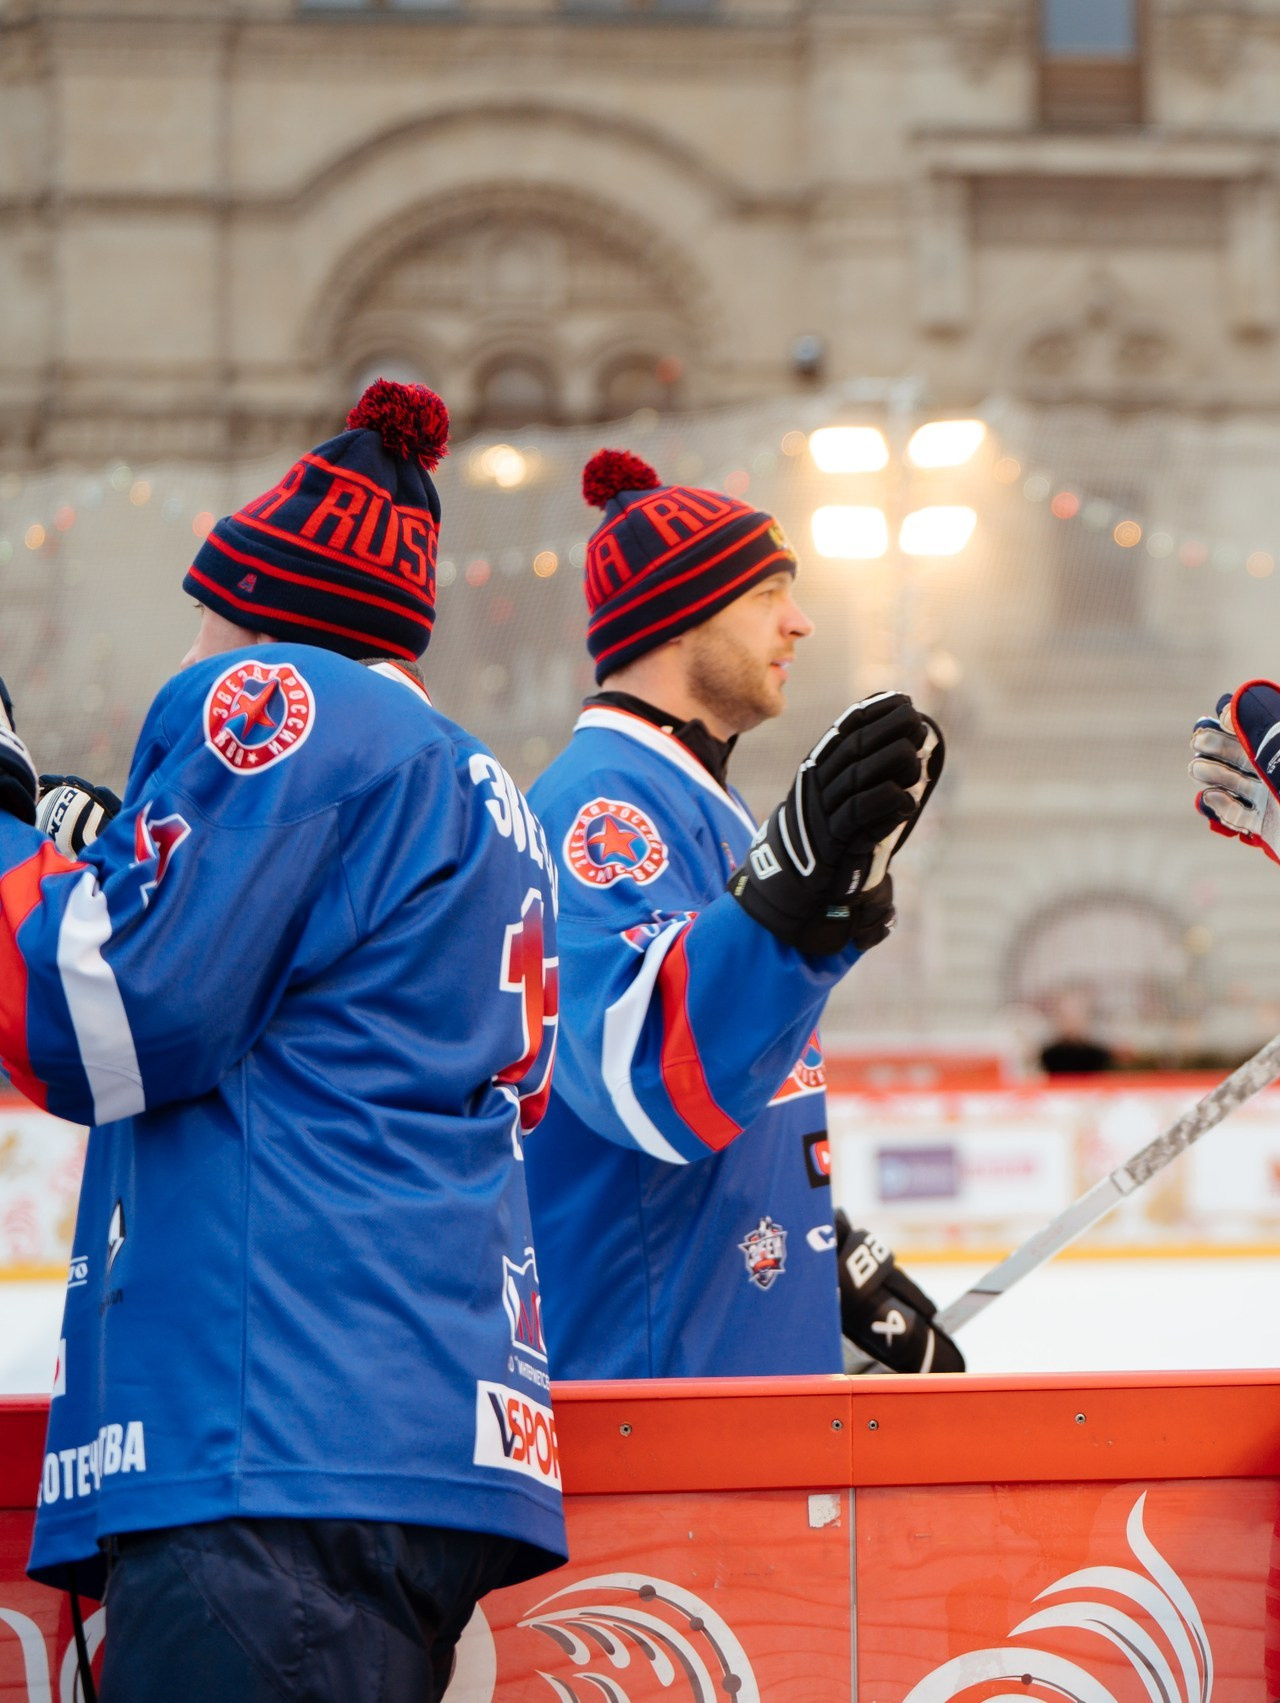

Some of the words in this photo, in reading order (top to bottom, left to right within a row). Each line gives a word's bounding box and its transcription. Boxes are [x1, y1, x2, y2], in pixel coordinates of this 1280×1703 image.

[211, 665, 280, 720] ЗВЕЗДА
[266, 675, 307, 756] РОССИИ
[46, 787, 79, 843] CCM
